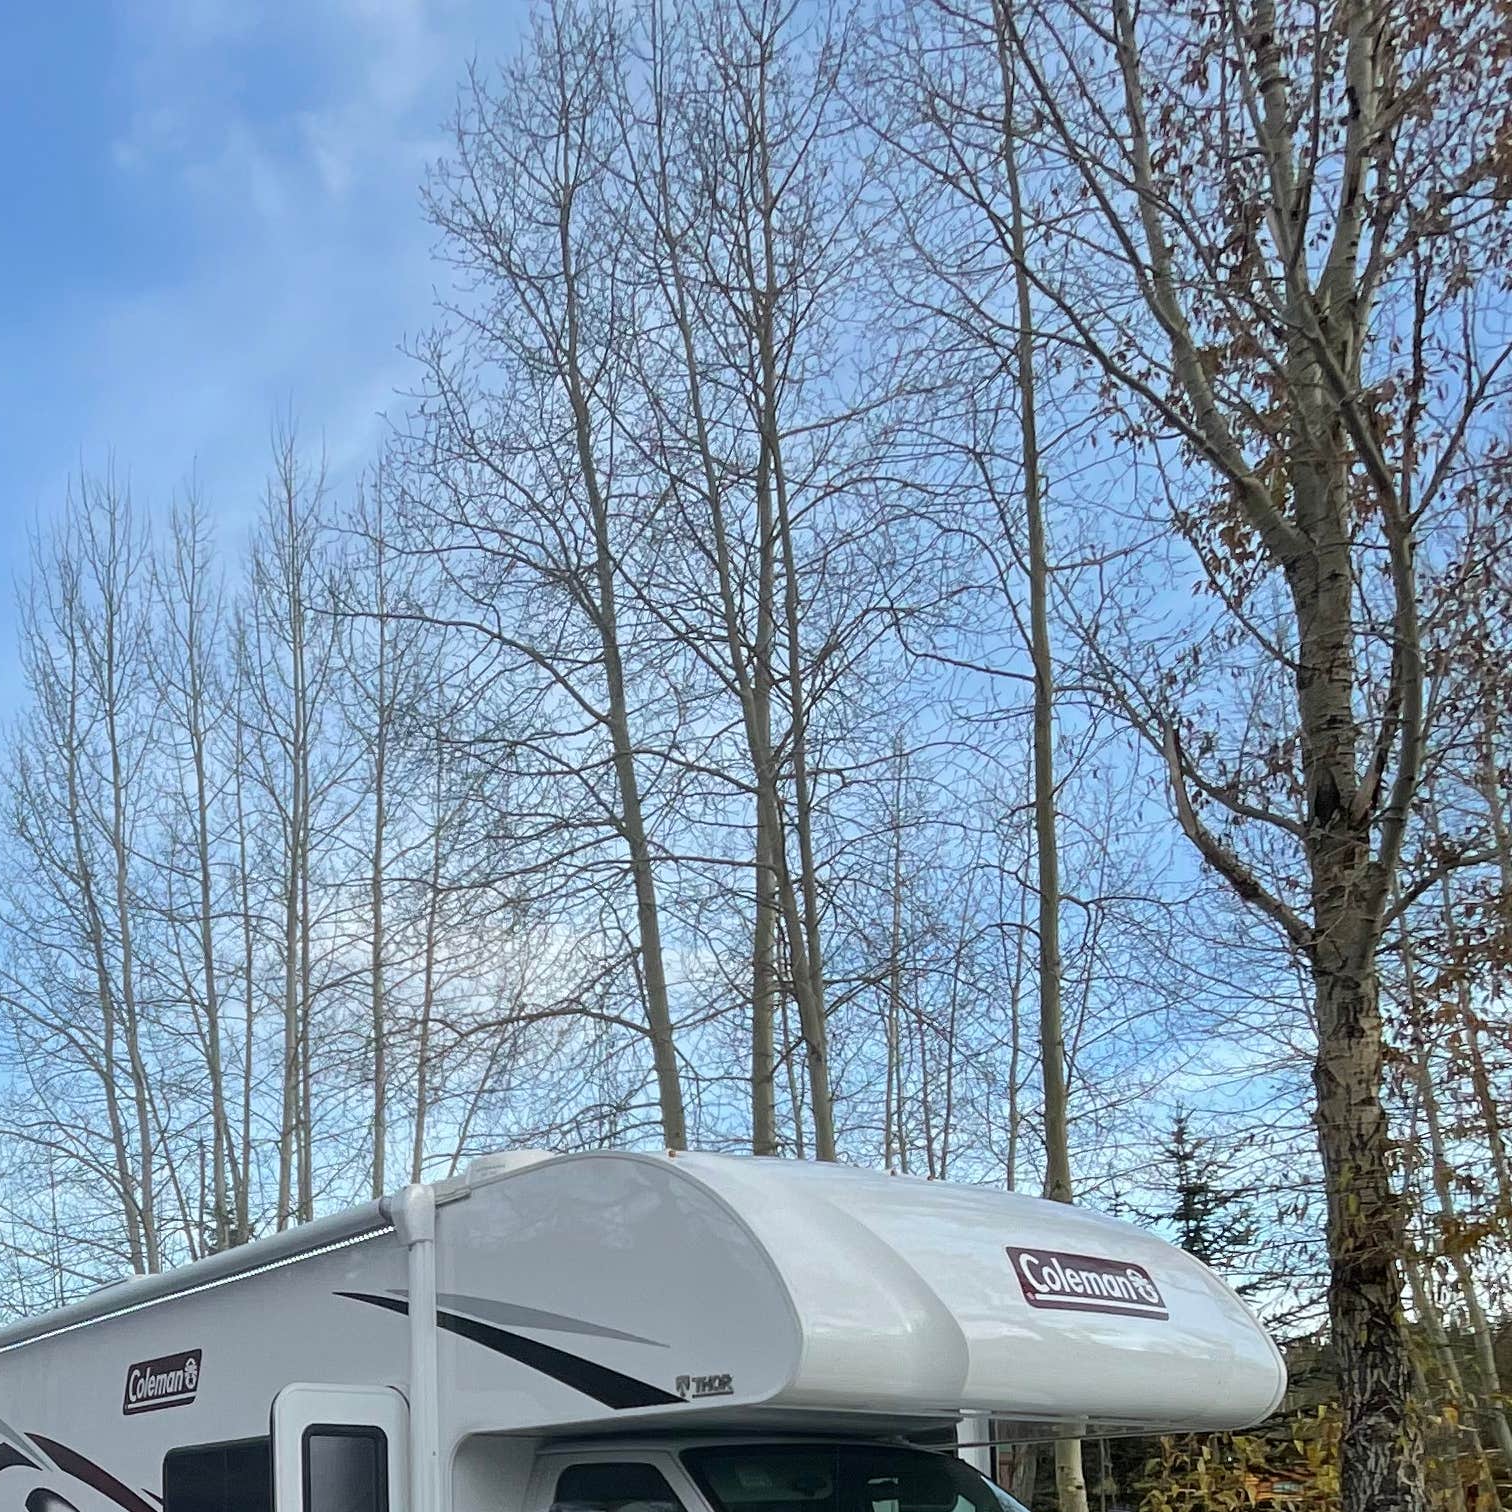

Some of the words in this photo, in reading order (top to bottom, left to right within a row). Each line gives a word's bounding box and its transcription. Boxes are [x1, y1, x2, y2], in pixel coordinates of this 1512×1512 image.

[1019, 1253, 1138, 1300] Coleman
[129, 1367, 184, 1402] Coleman
[692, 1374, 734, 1393] THOR
